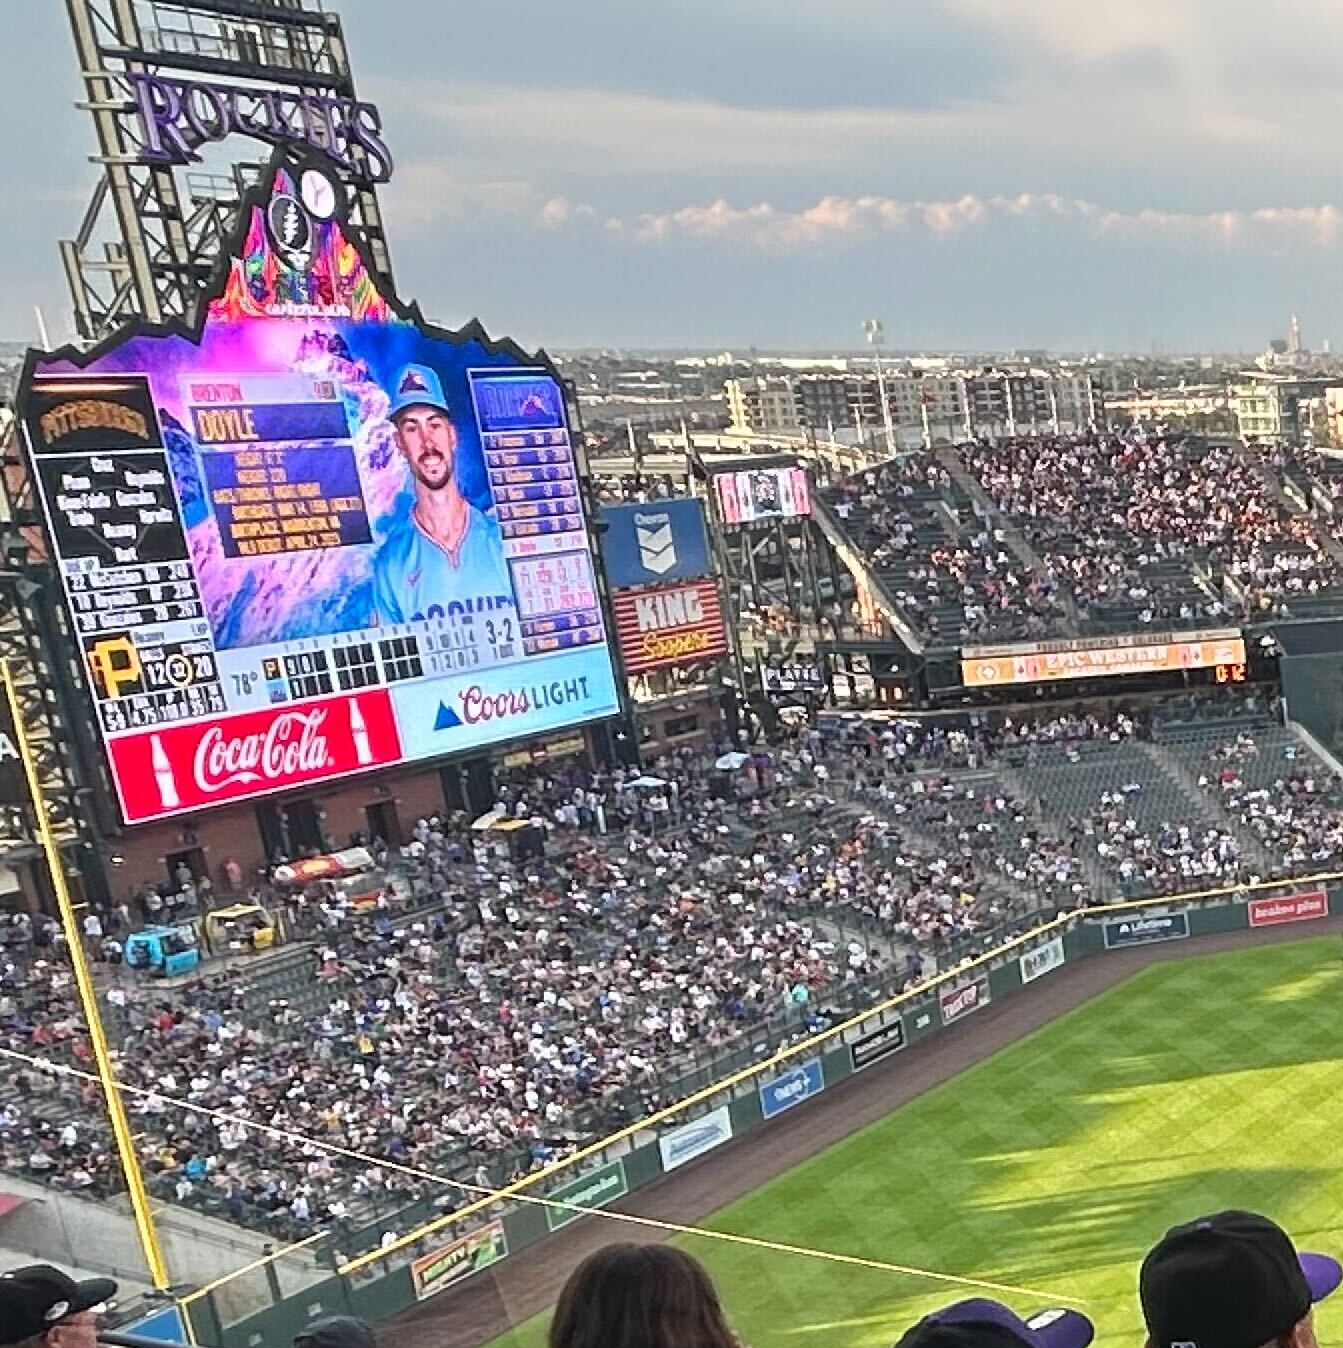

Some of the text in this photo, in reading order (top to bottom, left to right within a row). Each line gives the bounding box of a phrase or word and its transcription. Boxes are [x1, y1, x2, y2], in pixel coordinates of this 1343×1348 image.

[126, 73, 394, 183] ROCKIES
[197, 408, 260, 441] DOYLE
[485, 617, 515, 645] 3-2
[635, 589, 704, 632] KING
[458, 676, 592, 725] Coors LIGHT
[194, 709, 329, 792] Coca-Cola
[1296, 900, 1322, 916] plus
